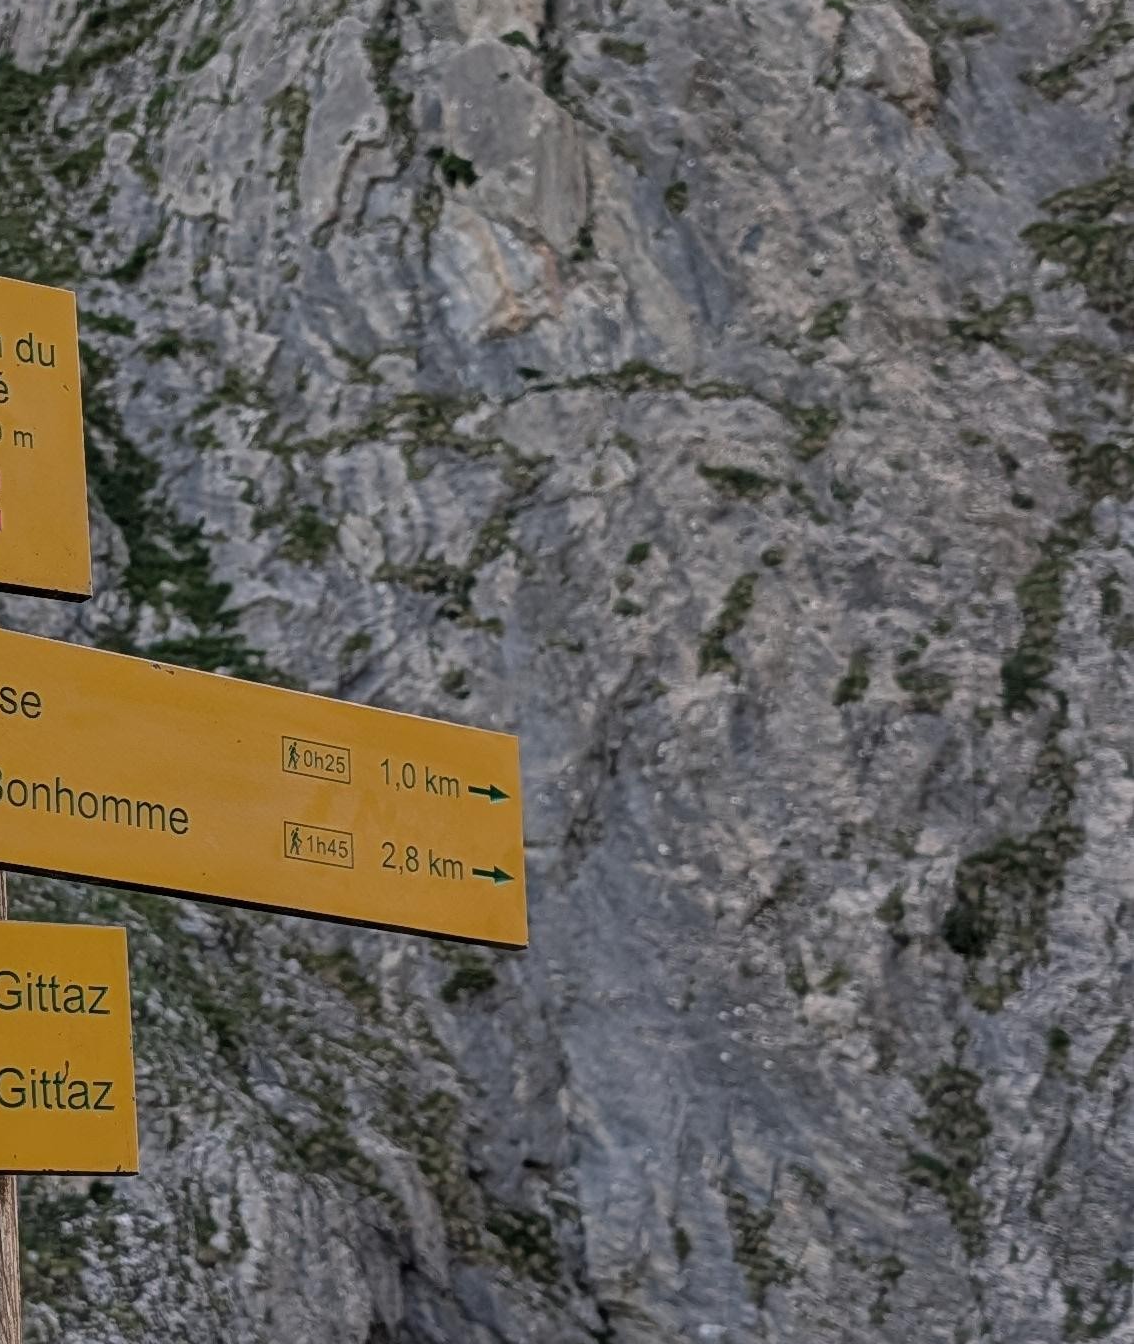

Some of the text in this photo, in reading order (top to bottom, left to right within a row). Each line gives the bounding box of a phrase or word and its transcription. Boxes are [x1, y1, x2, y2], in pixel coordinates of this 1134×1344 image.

[15, 332, 56, 368] du
[13, 430, 34, 449] m
[303, 749, 460, 799] 0h25 1,0 km
[306, 834, 464, 881] 1h45 2,8 km
